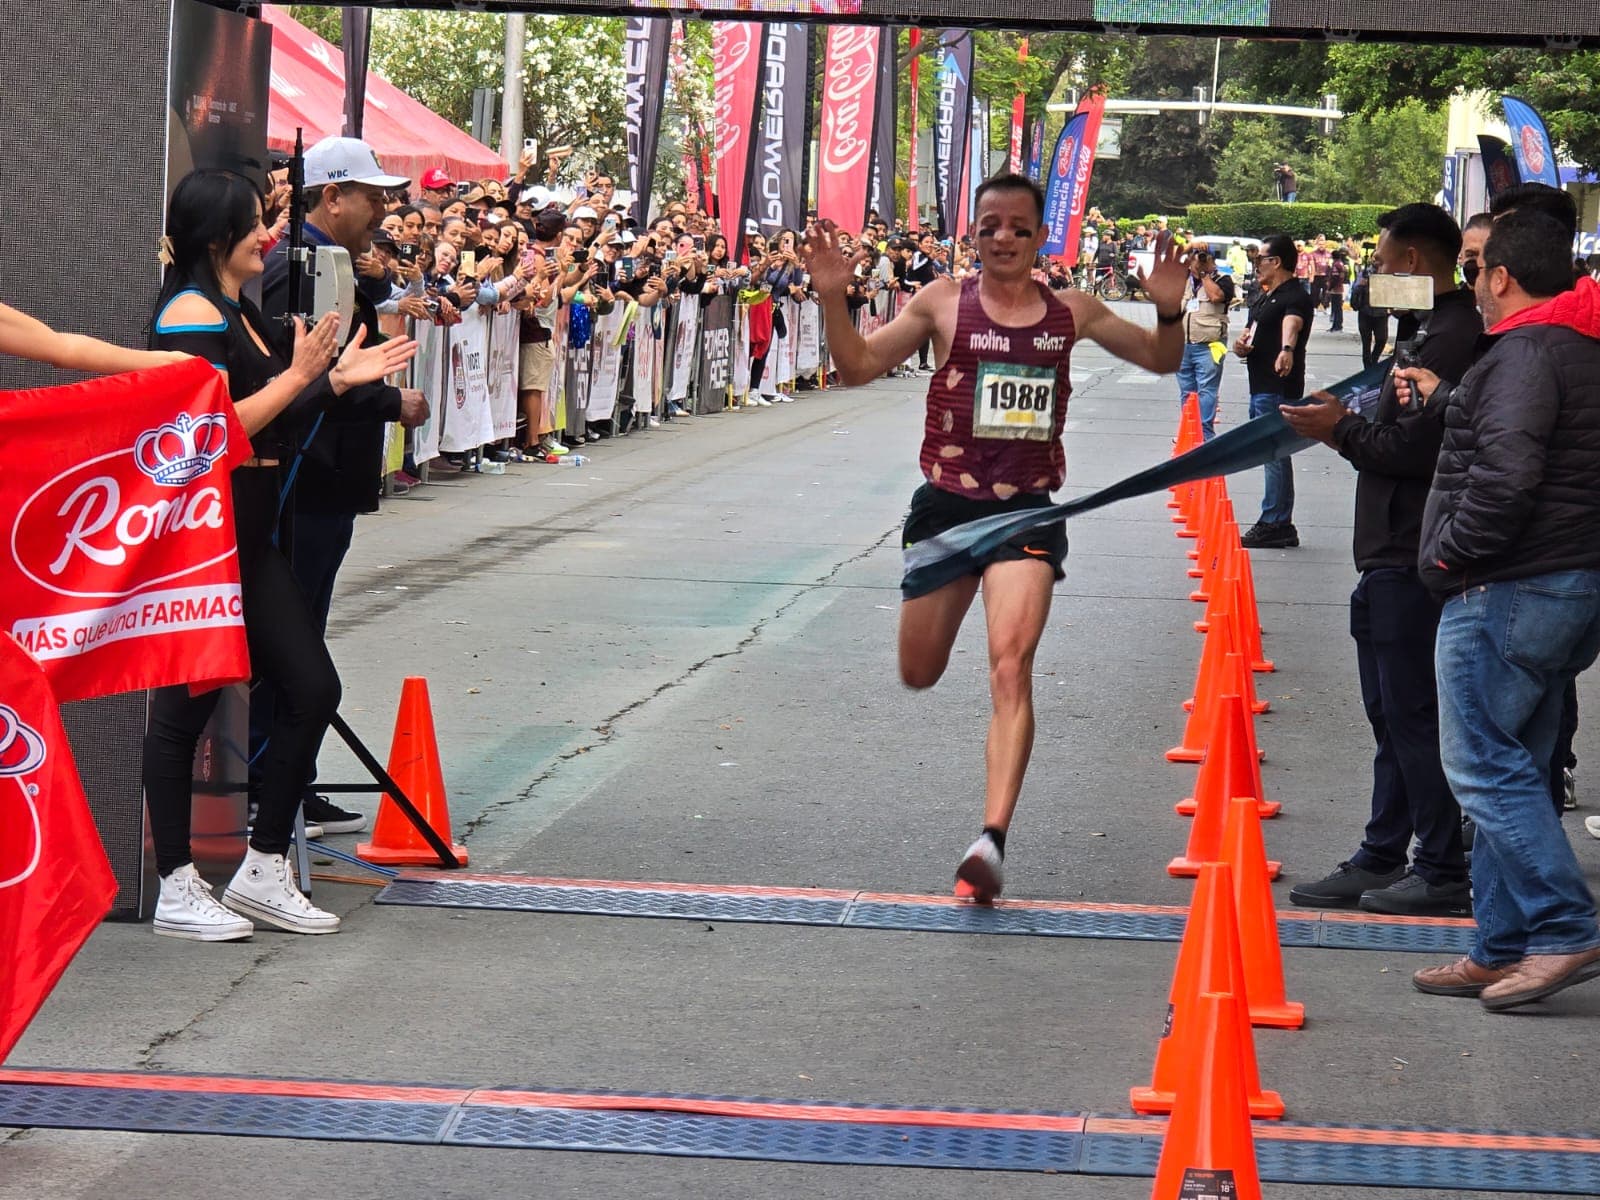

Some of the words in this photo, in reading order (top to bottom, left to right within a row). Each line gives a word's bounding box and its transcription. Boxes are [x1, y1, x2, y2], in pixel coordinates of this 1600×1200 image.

[327, 169, 348, 180] WBC
[1049, 200, 1057, 218] que
[1053, 180, 1061, 198] una
[1052, 182, 1070, 244] Farmacia
[970, 329, 1010, 353] molina
[987, 381, 1050, 411] 1988
[49, 475, 223, 576] Roma
[16, 621, 68, 654] MÁS
[74, 623, 108, 653] que
[107, 609, 136, 637] una
[141, 595, 242, 628] FARMAC
